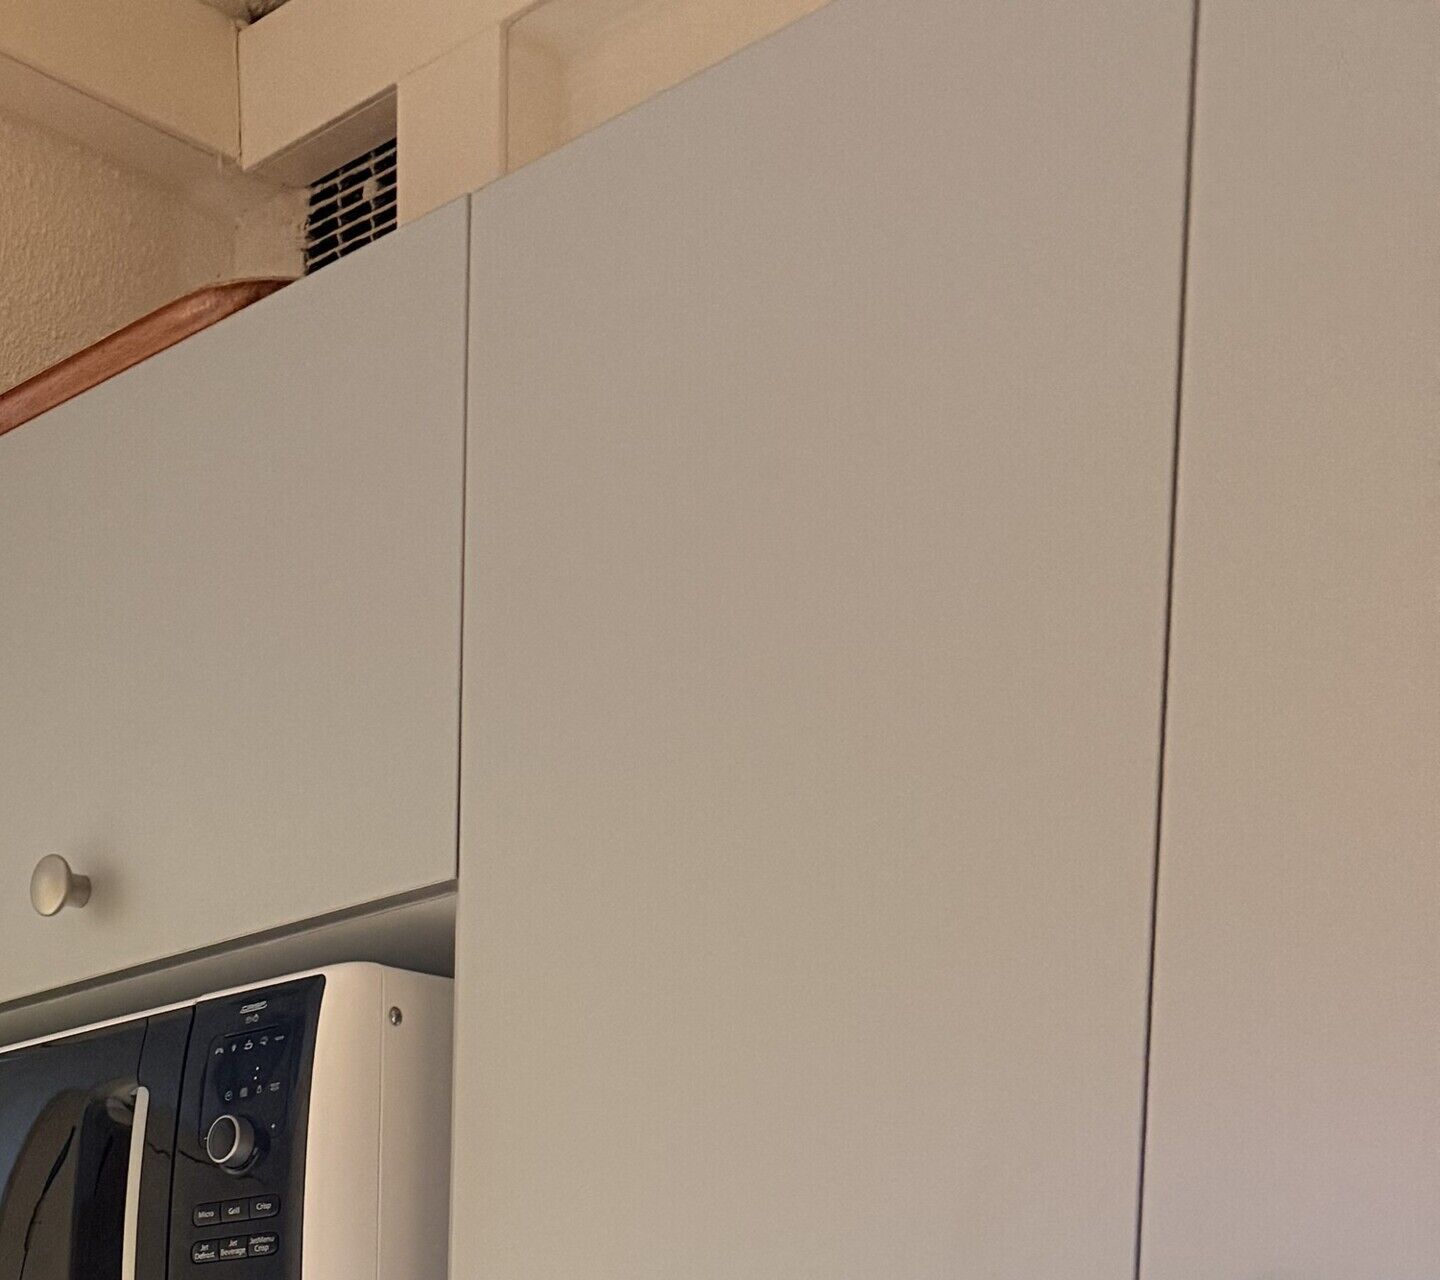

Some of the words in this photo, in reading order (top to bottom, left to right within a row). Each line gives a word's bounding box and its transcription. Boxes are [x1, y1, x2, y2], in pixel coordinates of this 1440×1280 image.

[228, 1206, 240, 1215] Grill
[255, 1202, 272, 1211] Crisp
[198, 1210, 215, 1218] Micro
[229, 1239, 238, 1247] Jet
[200, 1244, 209, 1252] Jet
[254, 1245, 270, 1253] Crisp
